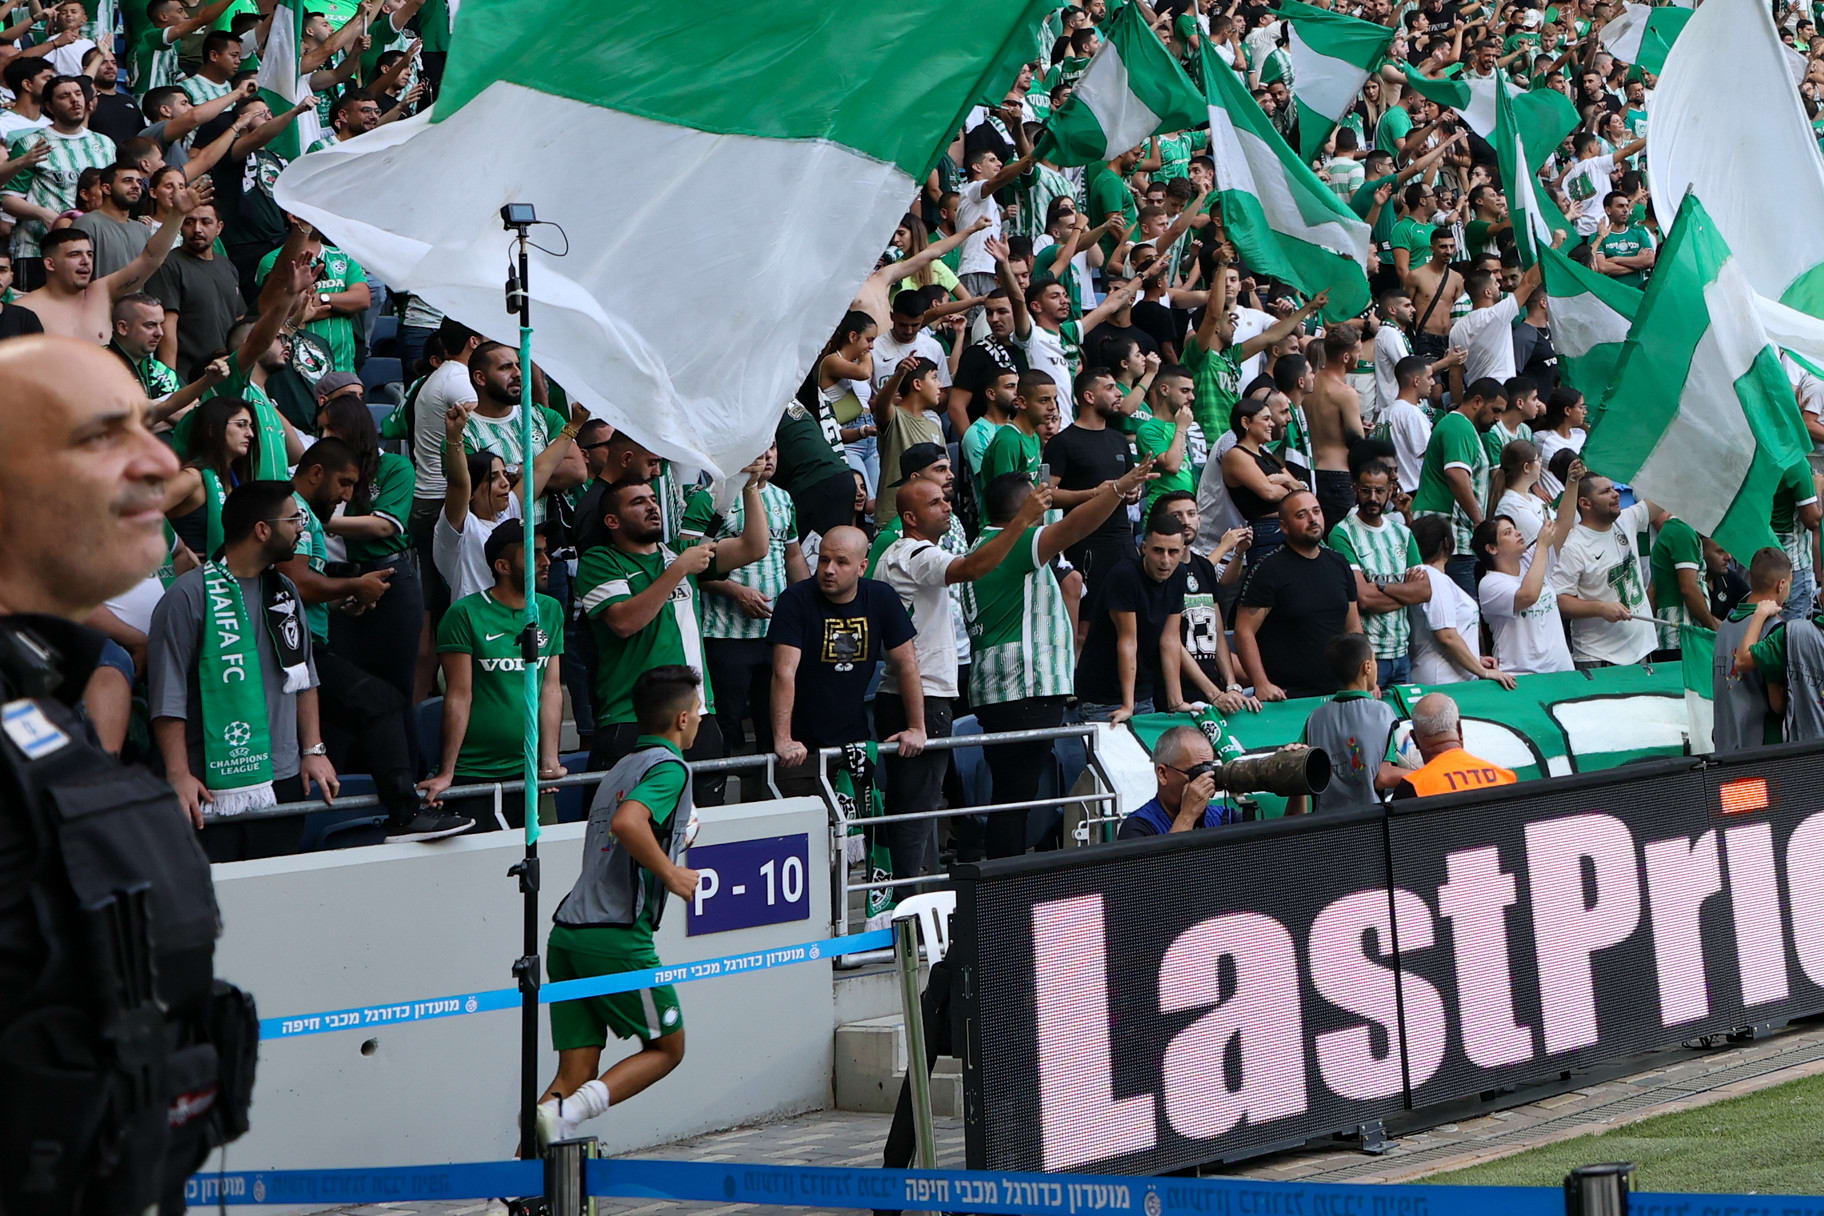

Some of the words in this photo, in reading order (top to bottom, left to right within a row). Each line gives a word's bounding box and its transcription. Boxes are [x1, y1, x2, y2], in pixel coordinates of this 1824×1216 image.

[206, 579, 241, 649] HAIFA
[221, 653, 245, 684] FC
[209, 752, 269, 769] CHAMPIONS
[220, 763, 260, 776] LEAGUE
[1444, 768, 1497, 790] סדרן
[695, 869, 720, 917] P
[760, 856, 803, 906] 10
[724, 955, 763, 972] כדורגל
[766, 947, 805, 968] מועדון
[655, 968, 687, 984] חיפה
[691, 962, 720, 977] מכבי
[363, 1005, 410, 1023] כדורגל
[413, 999, 460, 1019] מועדון
[282, 1018, 321, 1034] חיפה
[325, 1012, 360, 1028] מכבי
[905, 1178, 949, 1202] חיפה
[956, 1179, 998, 1204] מכבי
[1003, 1179, 1062, 1206] כדורגל
[1068, 1183, 1130, 1212] מועדון
